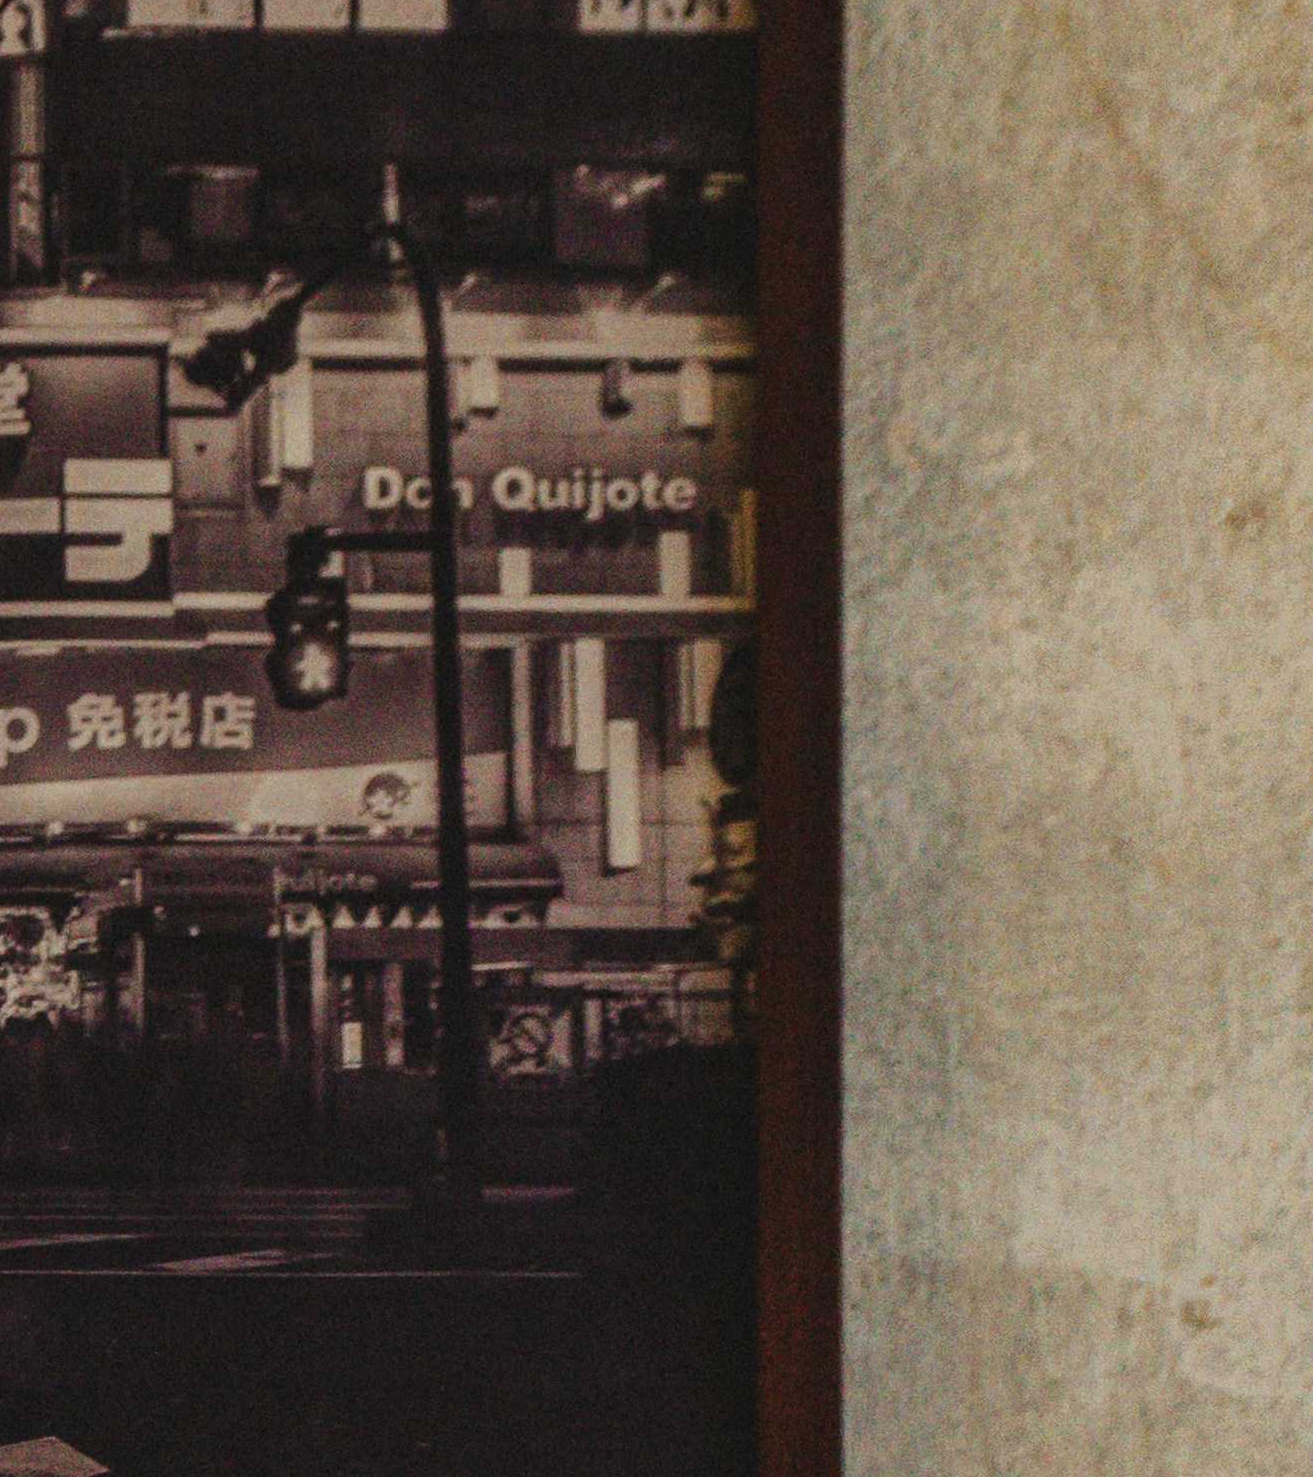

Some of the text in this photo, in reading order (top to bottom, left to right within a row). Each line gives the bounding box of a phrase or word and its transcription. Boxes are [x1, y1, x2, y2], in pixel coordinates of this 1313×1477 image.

[492, 467, 698, 522] Quijote
[66, 690, 256, 753] 免税店
